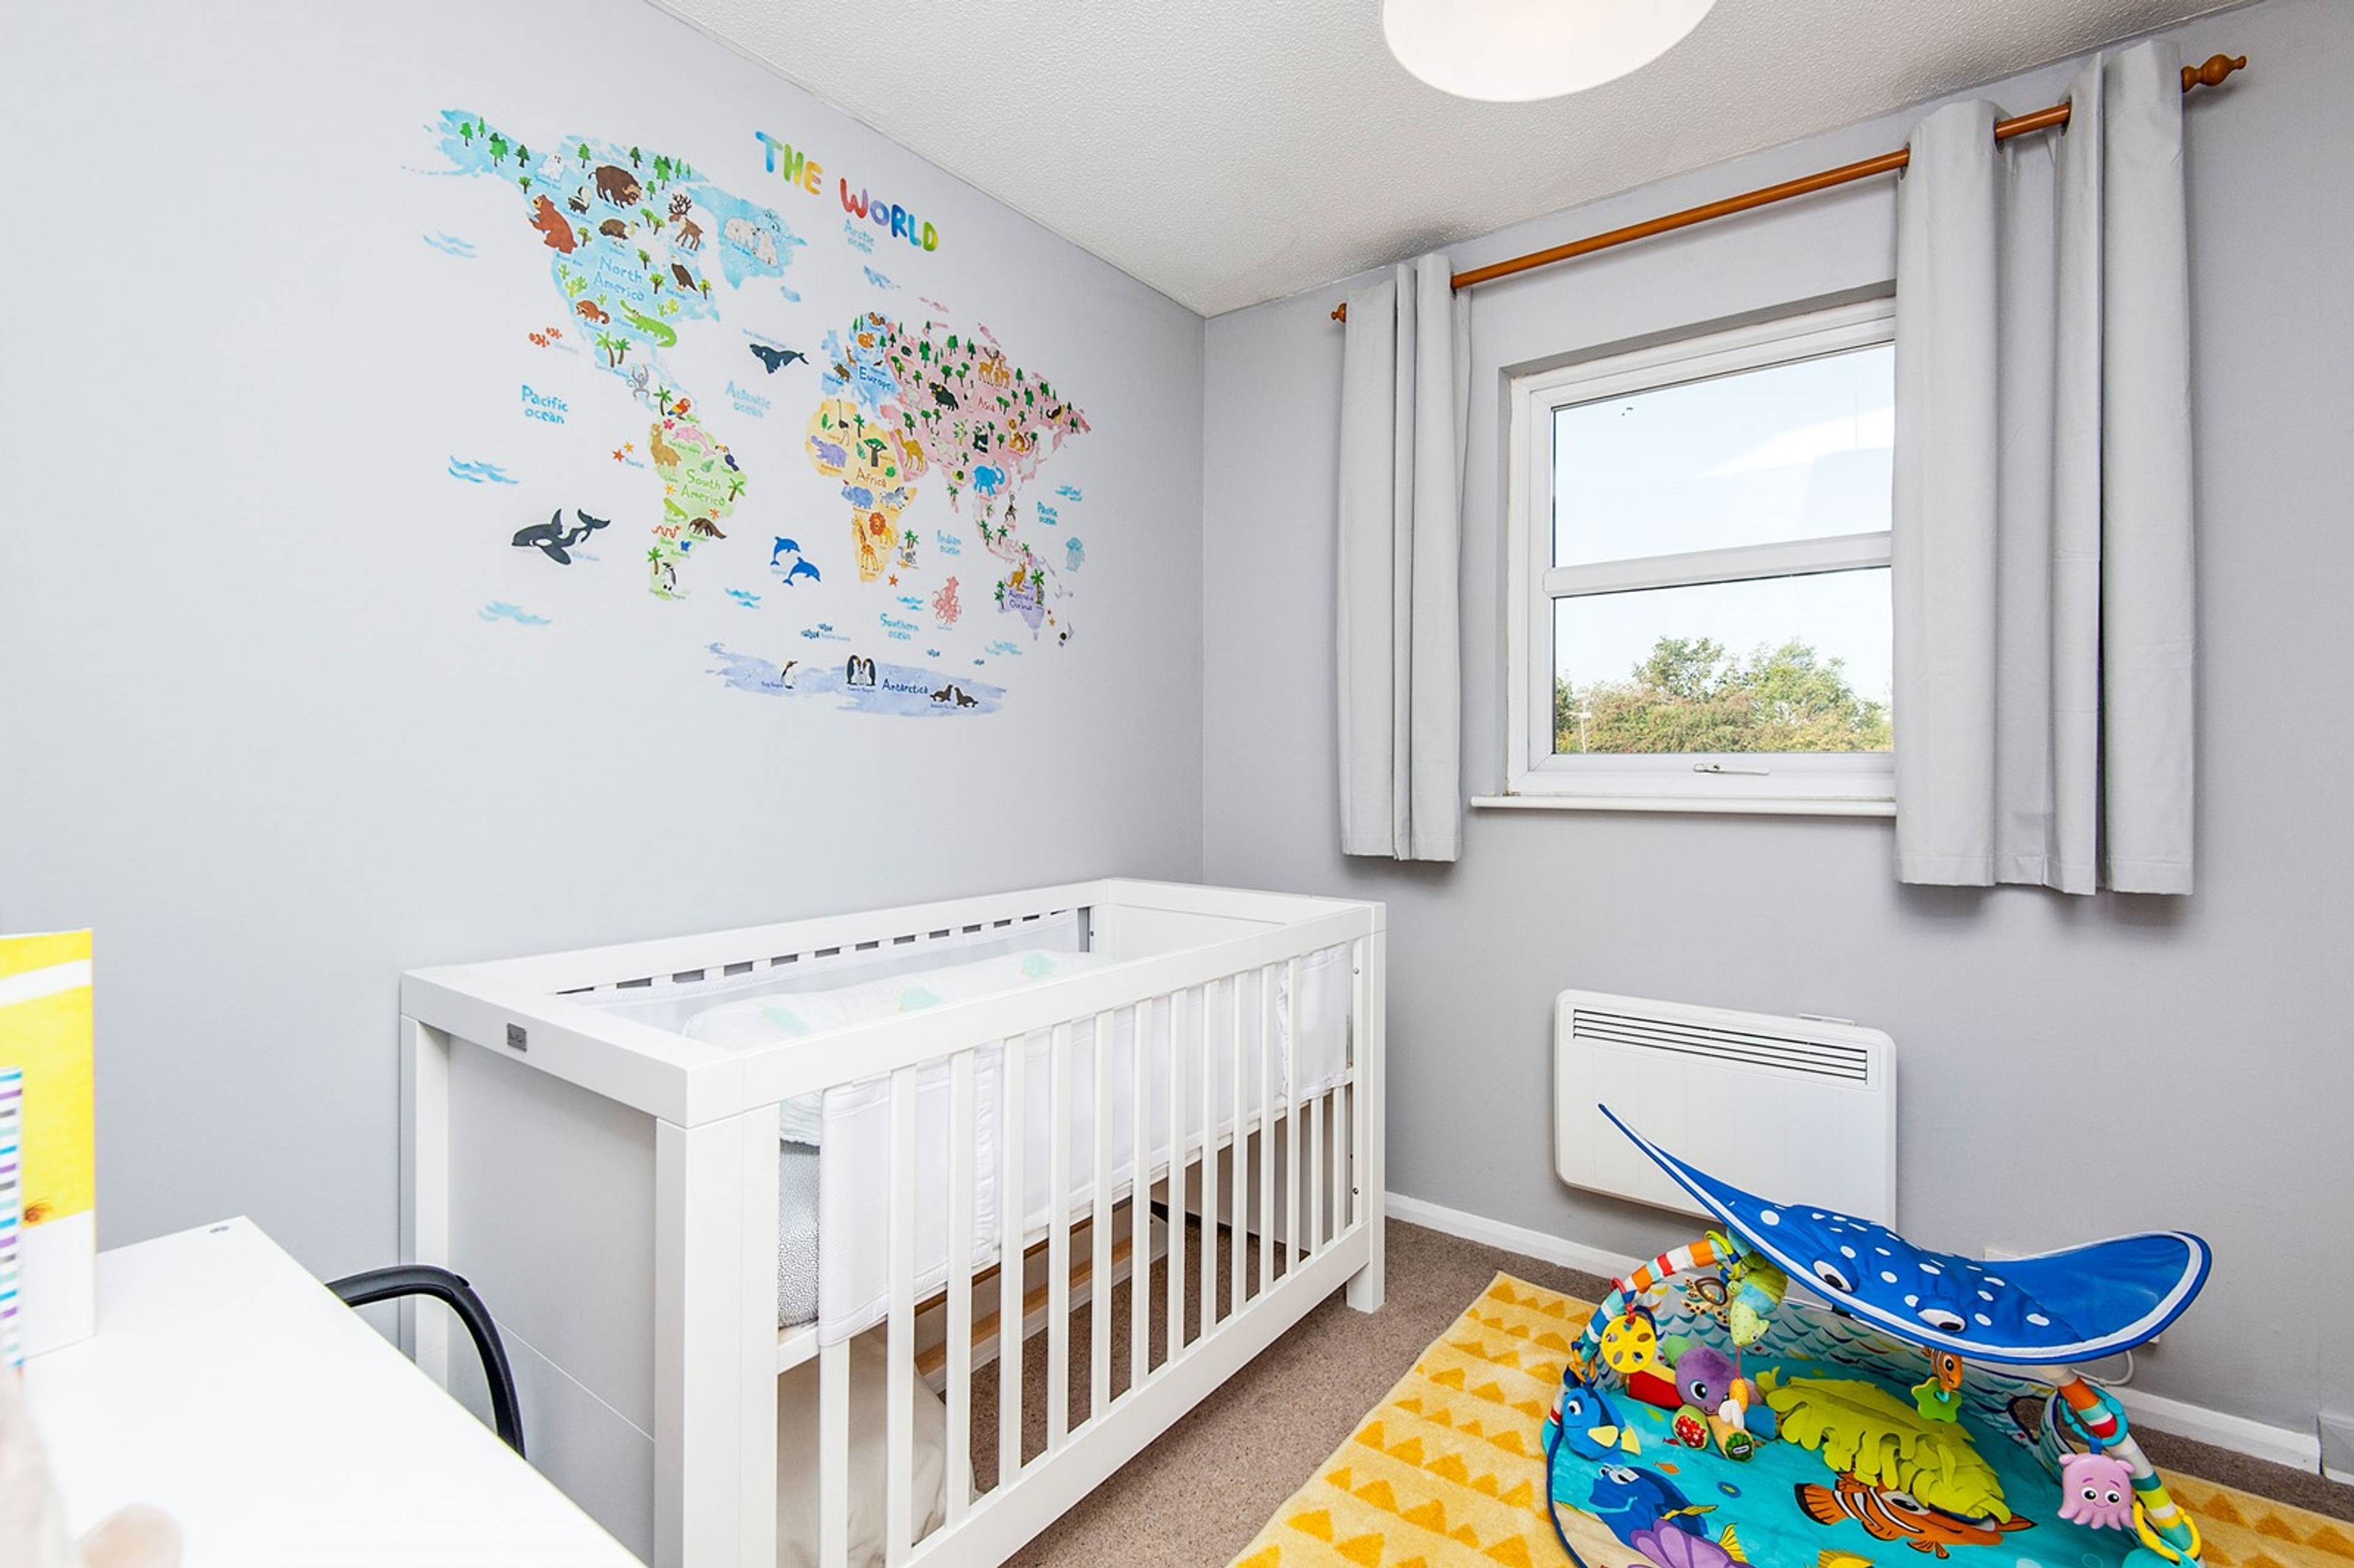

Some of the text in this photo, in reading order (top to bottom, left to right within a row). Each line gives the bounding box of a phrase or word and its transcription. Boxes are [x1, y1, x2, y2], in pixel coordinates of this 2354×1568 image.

[755, 131, 939, 252] THE WORLD
[600, 256, 642, 284] North
[593, 270, 644, 302] America
[522, 384, 568, 413] Pacific
[978, 396, 996, 412] Asia
[524, 408, 565, 424] ocean
[686, 469, 721, 490] South
[856, 467, 886, 488] Africa
[681, 484, 726, 507] America
[882, 677, 928, 694] Antarctica
